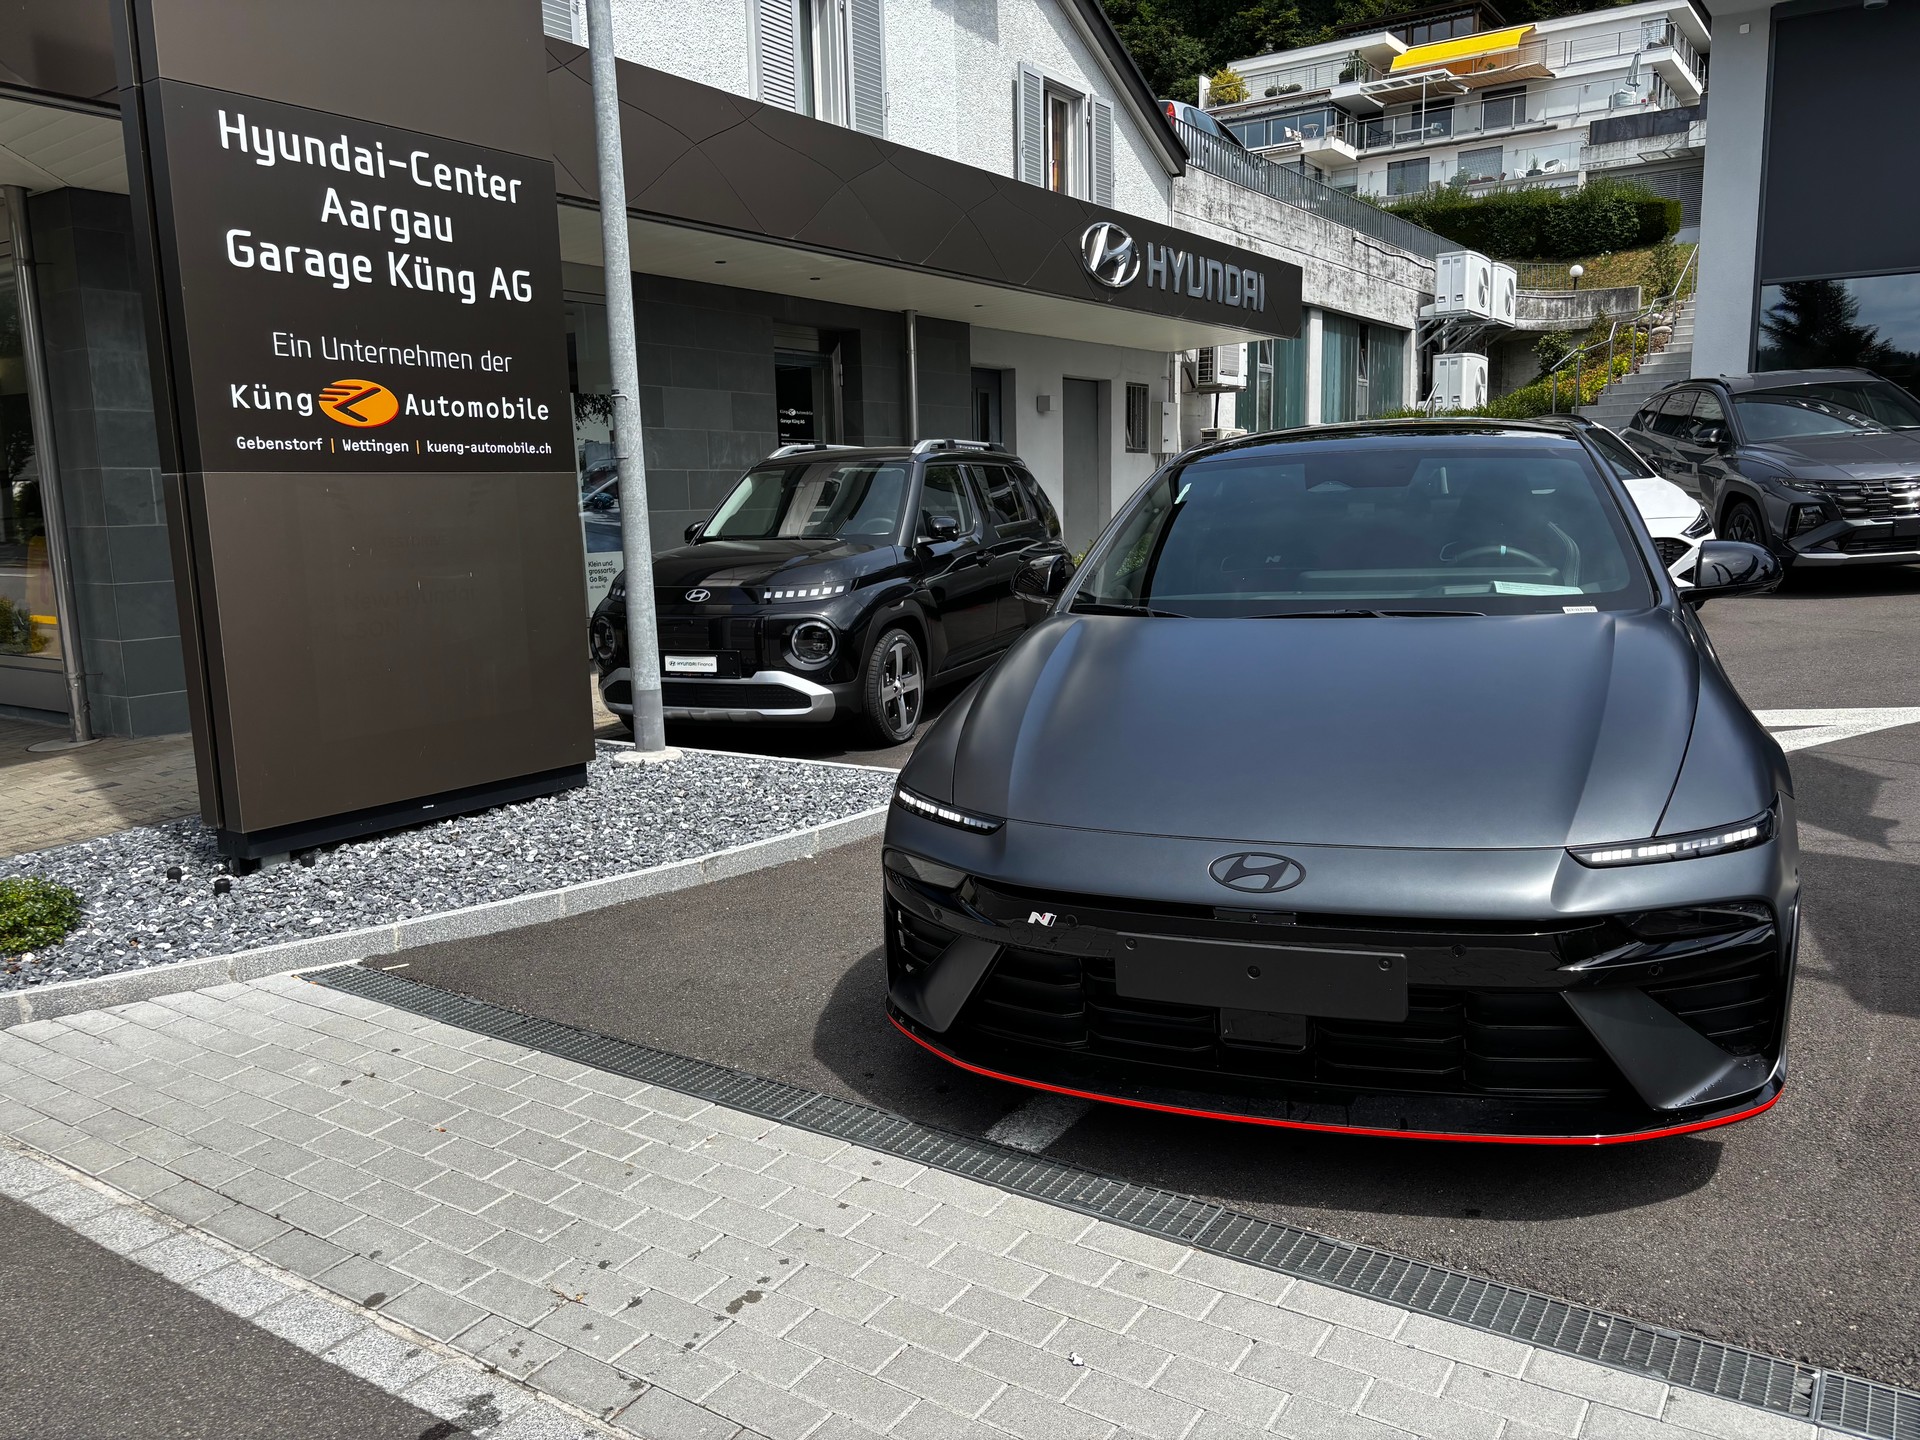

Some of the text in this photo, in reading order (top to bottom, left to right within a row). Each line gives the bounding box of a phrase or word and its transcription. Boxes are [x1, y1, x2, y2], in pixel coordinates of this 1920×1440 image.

[217, 109, 522, 204] Hyundai-Center
[320, 187, 453, 244] Aargau
[225, 228, 533, 305] Garage Küng AG
[1146, 241, 1265, 313] HYUNDAI
[272, 331, 513, 373] Ein Unternehmen der
[230, 383, 549, 421] Küng Automobile
[236, 436, 552, 455] Gebenstorf Wettingen kueng-automobile.ch
